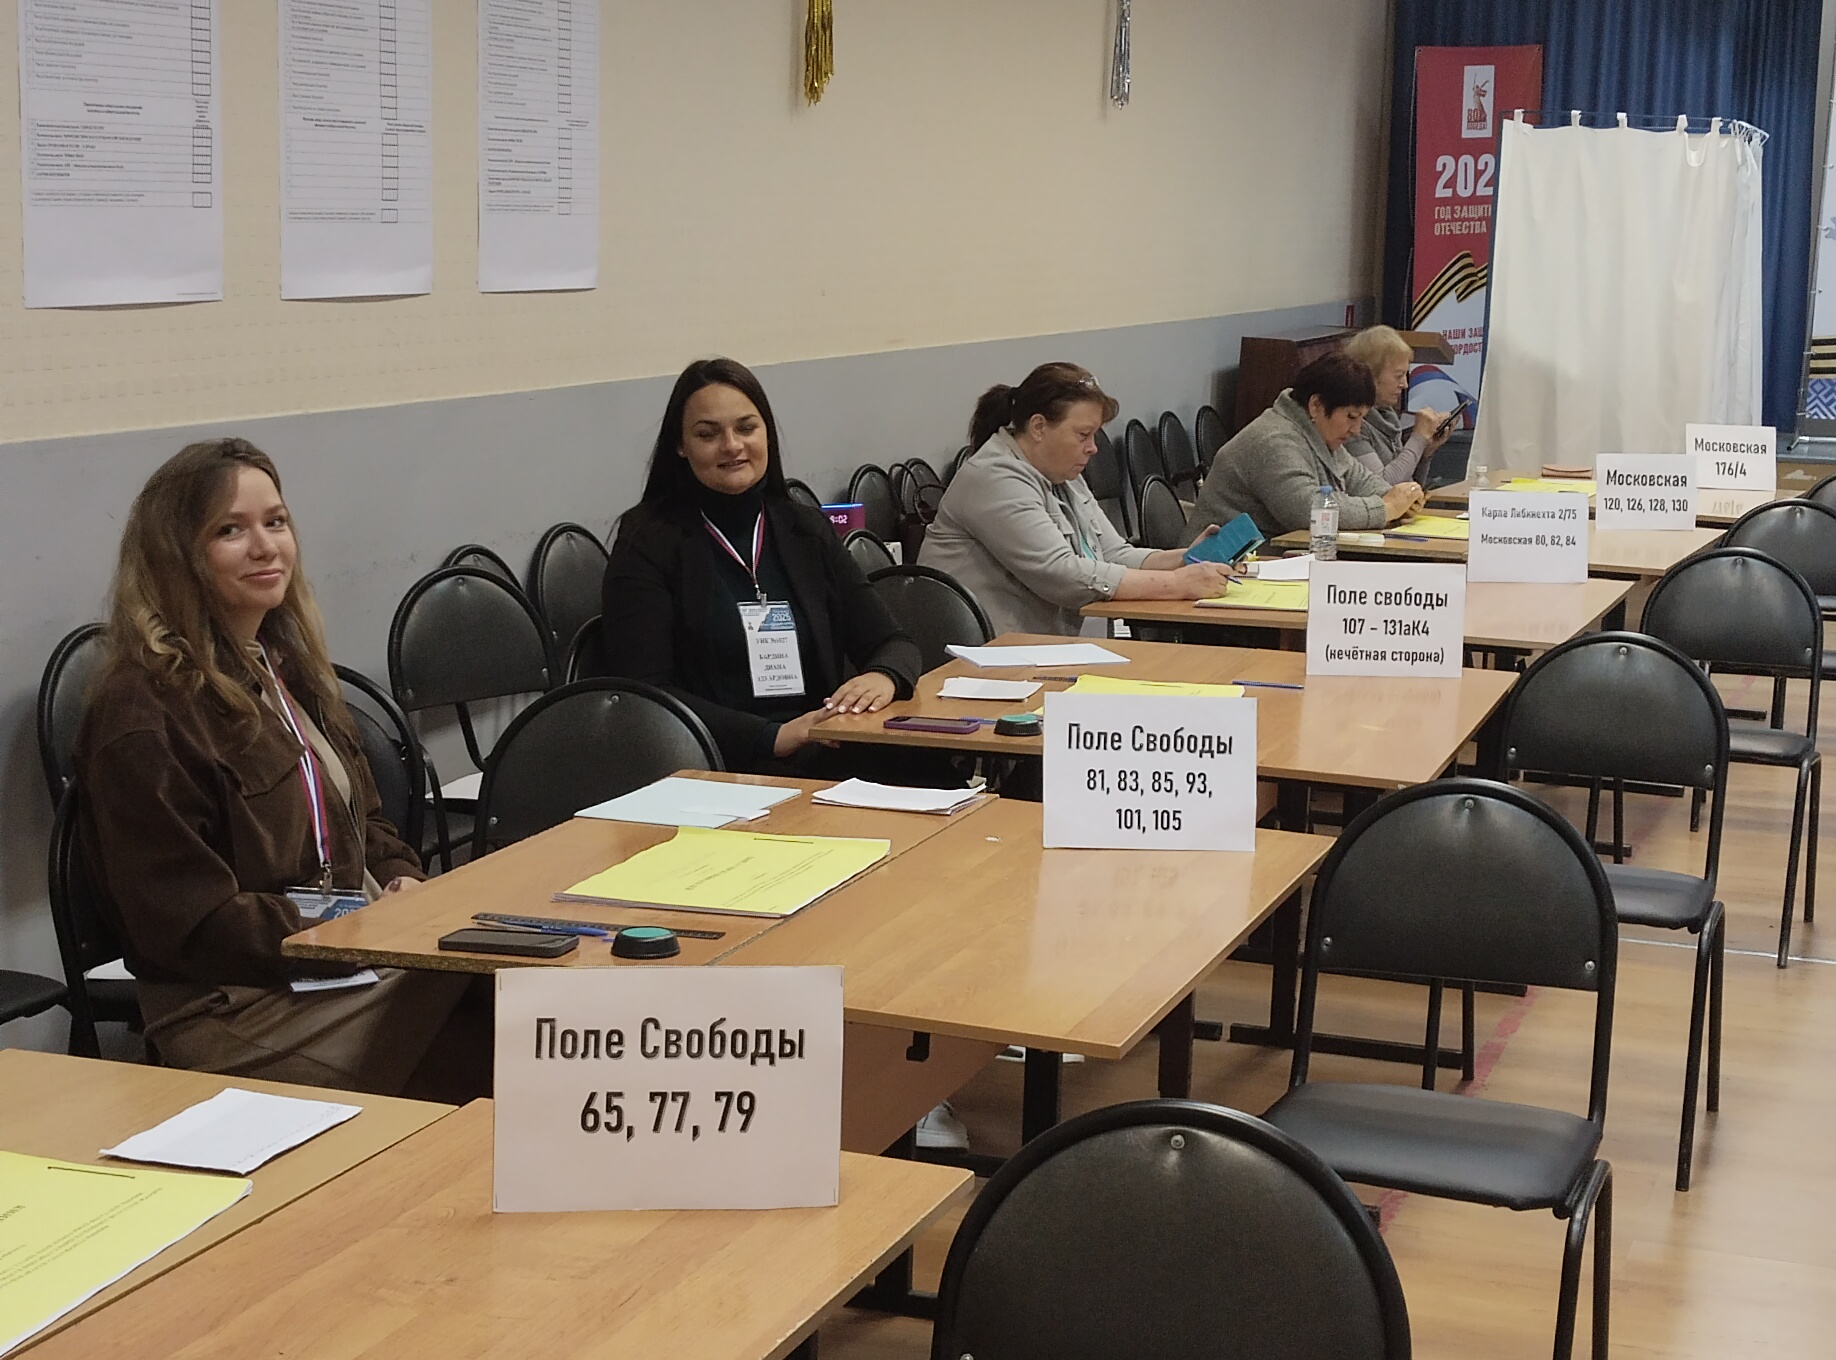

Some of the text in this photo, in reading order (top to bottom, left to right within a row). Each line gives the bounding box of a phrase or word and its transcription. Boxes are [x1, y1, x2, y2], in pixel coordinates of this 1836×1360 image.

[1435, 153, 1495, 198] 202
[1434, 206, 1451, 220] ГОД
[1434, 221, 1487, 236] ОТЕЧЕСТВА
[1694, 437, 1767, 454] Московская
[1606, 469, 1687, 487] Московская
[1715, 461, 1747, 479] 176/4
[1481, 507, 1577, 521] Карла Либкнехта 2/75
[1604, 498, 1689, 513] 120, 126, 128, 130
[1481, 534, 1533, 545] Московская
[1565, 536, 1576, 546] 84
[1327, 584, 1448, 610] Поле свободы
[1342, 618, 1366, 635] 107
[1383, 619, 1430, 636] 131аК4
[1325, 644, 1445, 665] (нечётная сторона)
[1068, 723, 1233, 758] Поле Свободы
[1086, 769, 1213, 798] 81, 83, 85, 93,
[1116, 808, 1182, 833] 101, 105
[535, 1017, 807, 1067] Поле Свободы
[580, 1091, 758, 1143] 65, 77, 79
